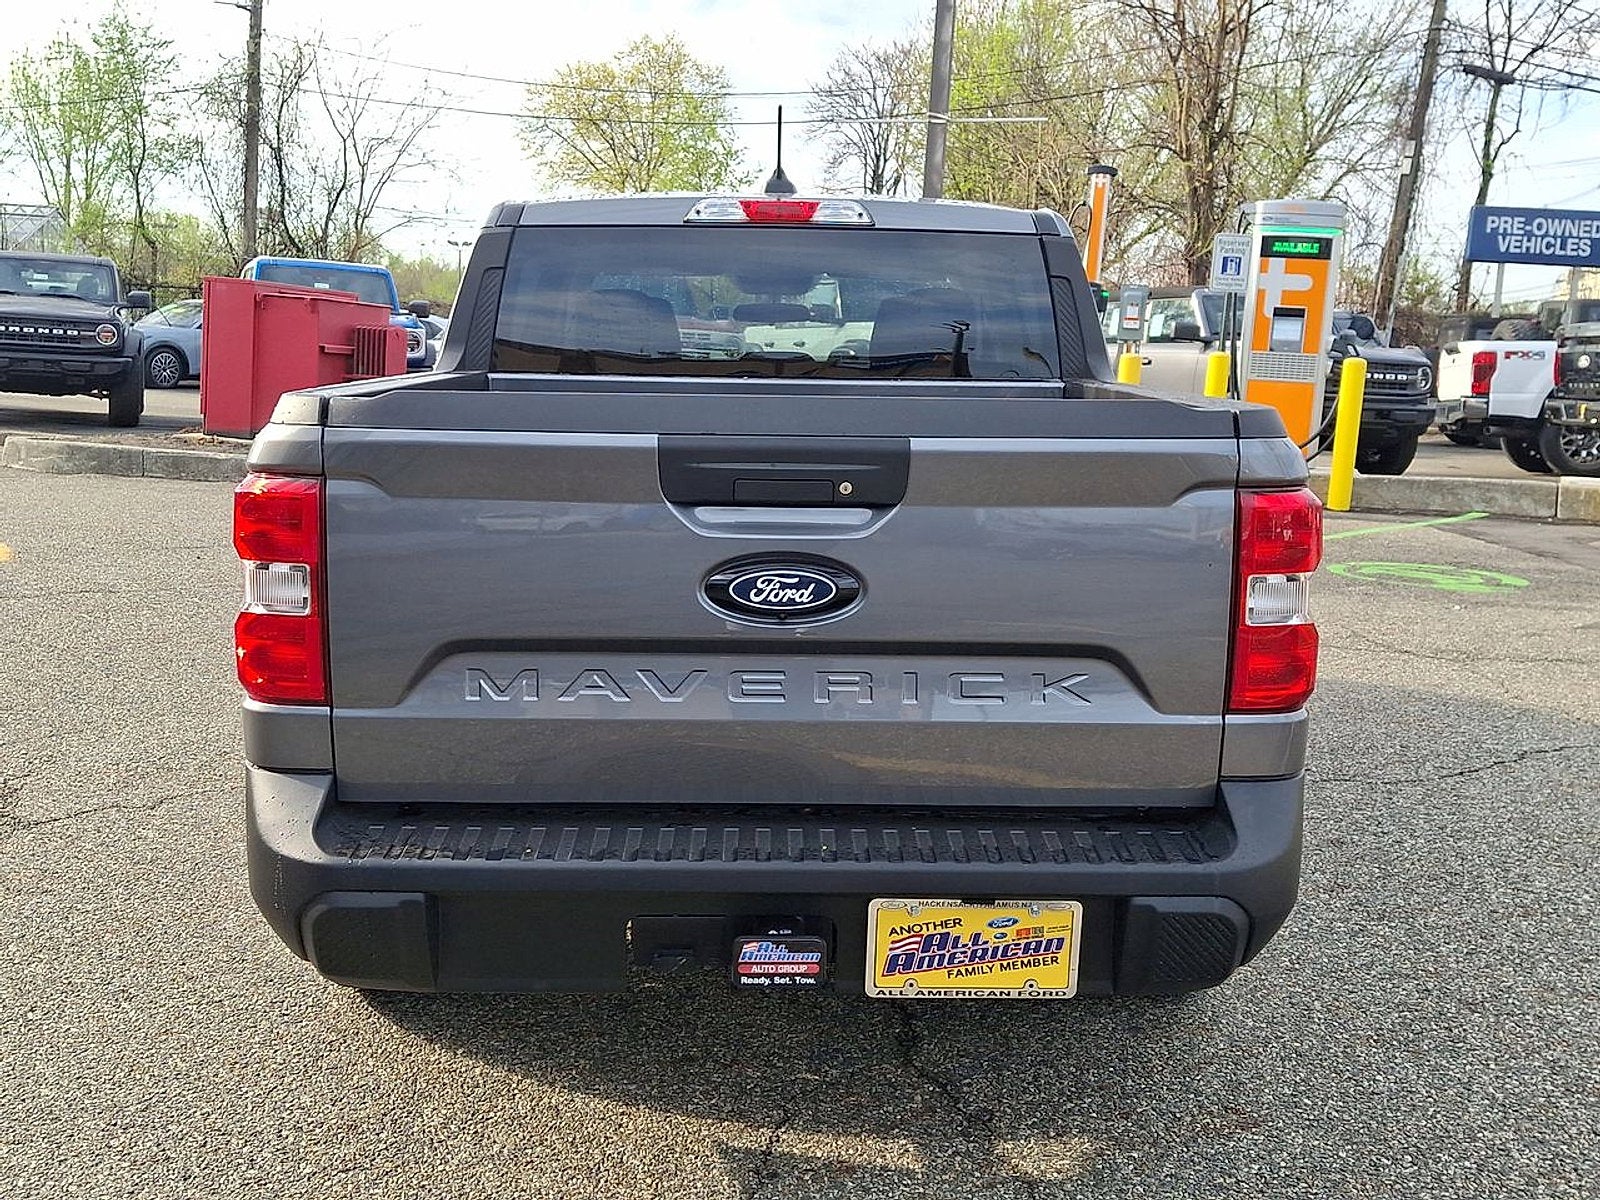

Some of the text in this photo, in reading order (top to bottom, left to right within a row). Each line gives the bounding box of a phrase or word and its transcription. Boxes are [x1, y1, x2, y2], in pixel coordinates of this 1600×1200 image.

[1486, 215, 1600, 239] PRE-OWNED
[1272, 241, 1320, 253] AVAILABLE
[1497, 234, 1592, 257] VEHICLES
[750, 576, 816, 603] Ford
[465, 668, 1092, 705] MAVERICK
[888, 918, 963, 937] ANOTHER
[757, 941, 789, 953] ALL
[920, 931, 990, 954] ALL
[740, 950, 821, 962] AMERICAN
[883, 937, 1065, 976] AMERICAN
[751, 964, 808, 973] AUTO GROUP
[947, 955, 1060, 979] FAMILY MEMBER
[741, 976, 816, 986] Ready. Set. Tow.
[875, 989, 1068, 997] ALL AMERICAN FORD
